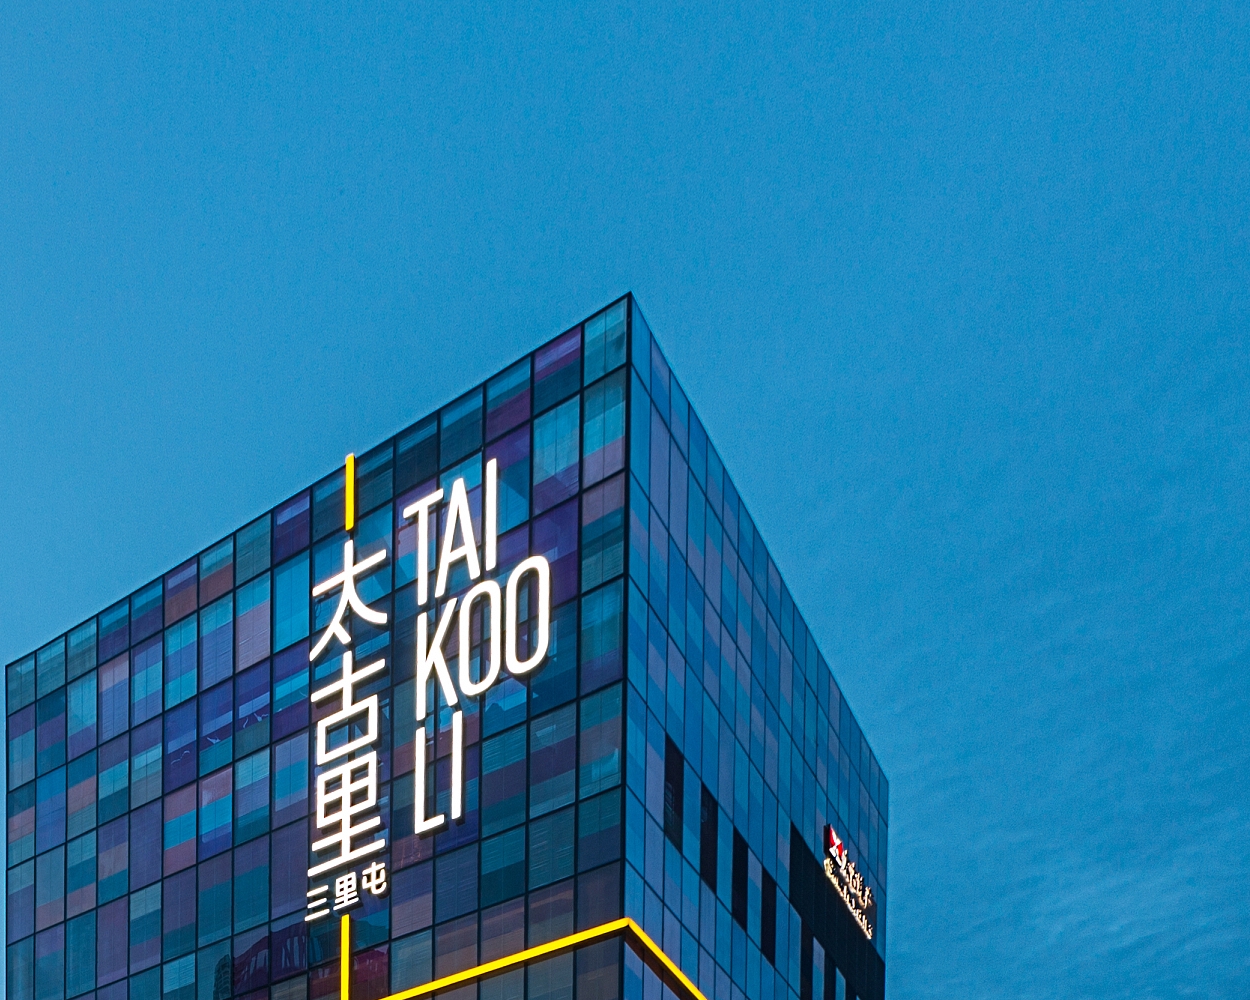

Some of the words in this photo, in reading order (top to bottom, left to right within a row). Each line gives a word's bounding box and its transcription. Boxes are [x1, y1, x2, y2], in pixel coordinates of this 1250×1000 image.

[403, 458, 497, 606] TAI
[308, 539, 388, 877] 太古里
[416, 555, 550, 721] KOO
[414, 710, 463, 836] LI
[304, 861, 387, 922] 三里屯
